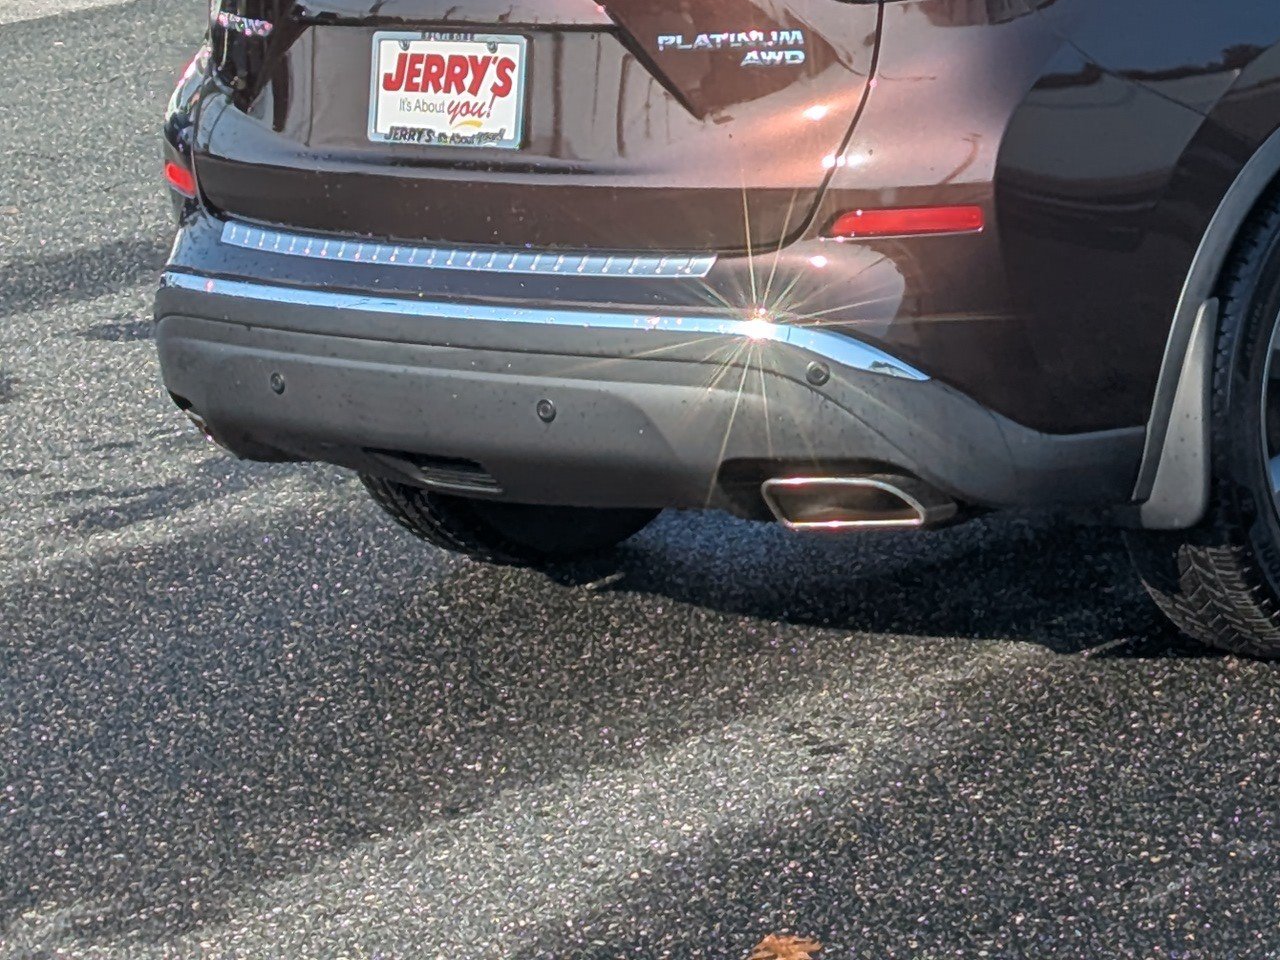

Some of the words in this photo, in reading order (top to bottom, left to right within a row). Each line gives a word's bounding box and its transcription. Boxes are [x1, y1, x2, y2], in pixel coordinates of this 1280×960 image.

[657, 30, 805, 51] PLATINUM
[740, 50, 805, 66] AWD
[382, 52, 517, 98] JERRY'S
[399, 98, 412, 112] It's
[413, 97, 445, 114] About
[447, 94, 496, 126] you!
